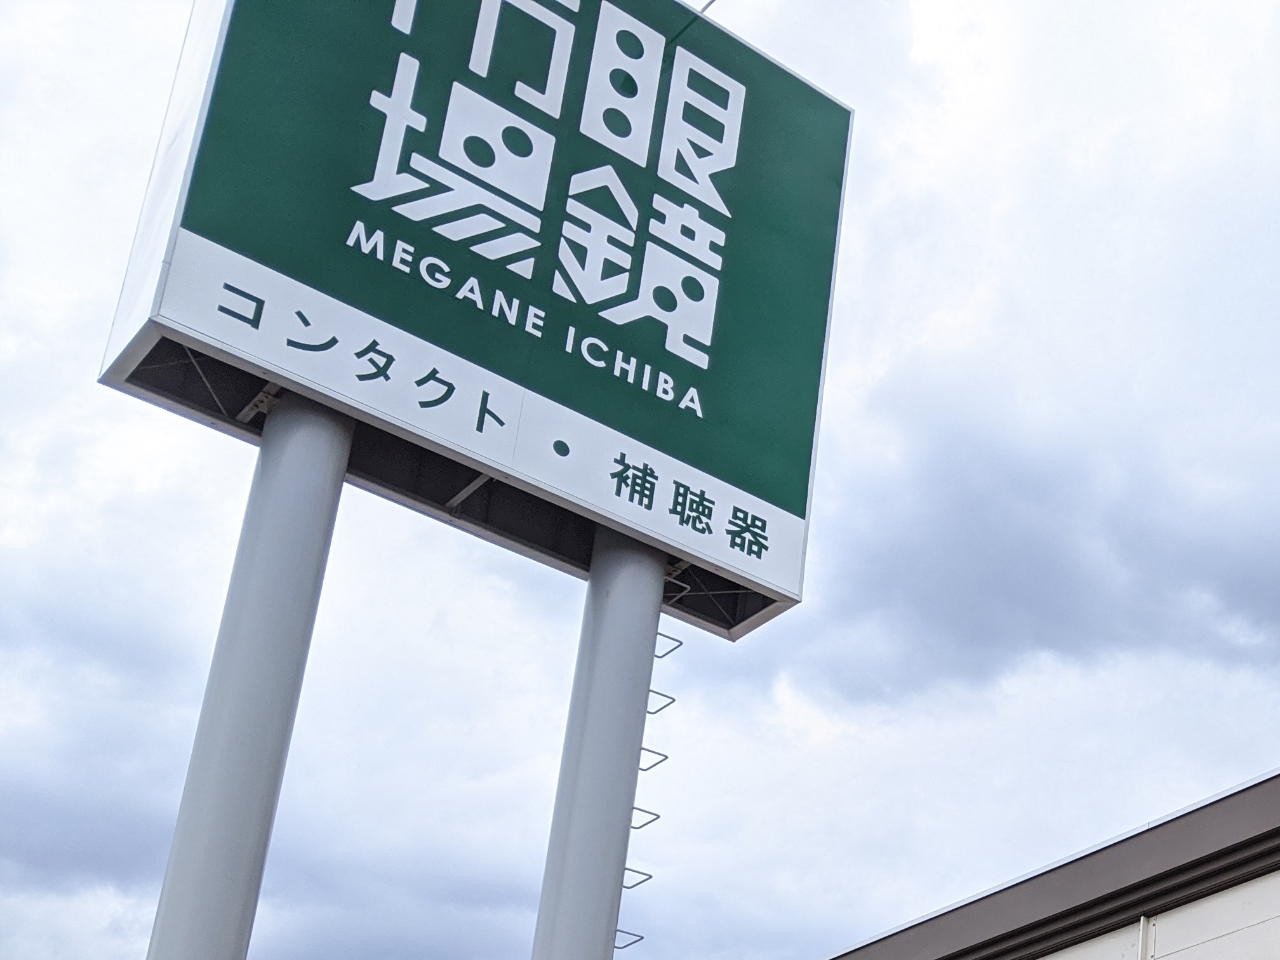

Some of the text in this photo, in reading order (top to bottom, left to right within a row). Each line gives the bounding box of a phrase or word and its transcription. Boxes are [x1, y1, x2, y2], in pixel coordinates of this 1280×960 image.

[217, 281, 770, 561] コンタクト・補聴器
[346, 220, 705, 419] MEGANE ICHIBA
